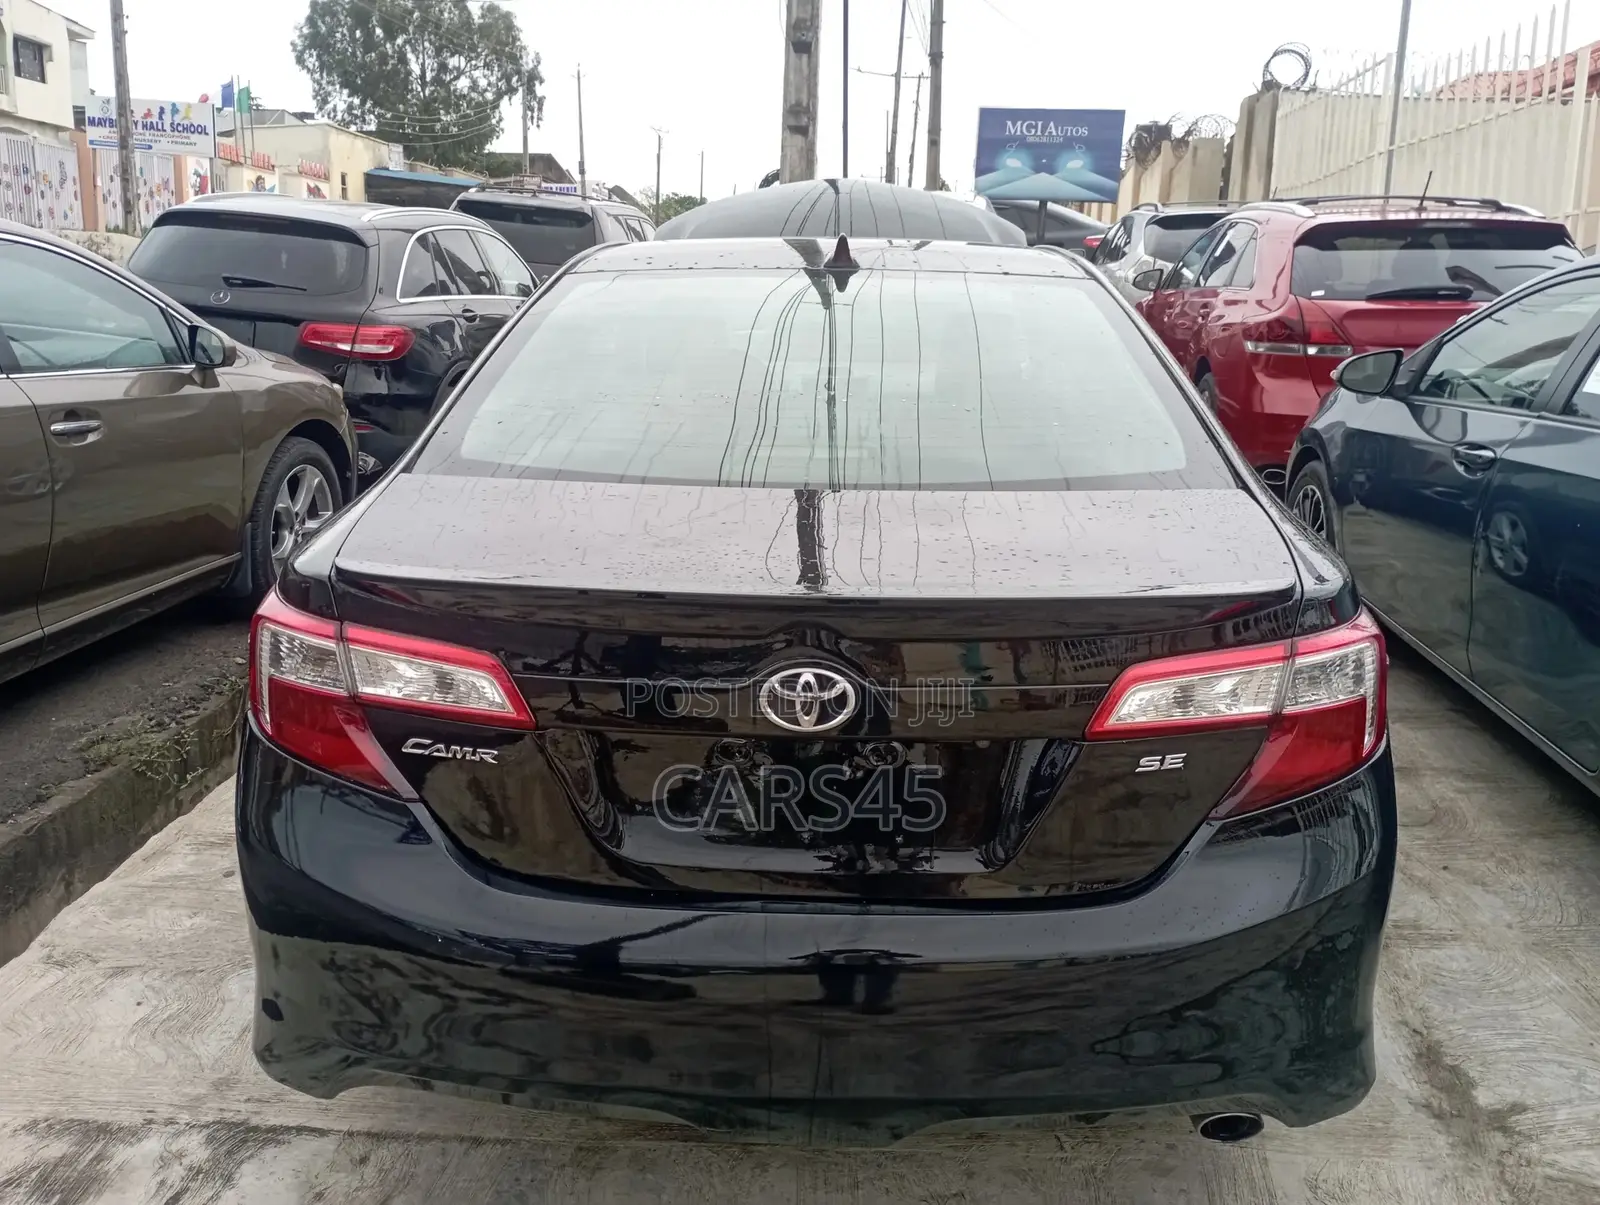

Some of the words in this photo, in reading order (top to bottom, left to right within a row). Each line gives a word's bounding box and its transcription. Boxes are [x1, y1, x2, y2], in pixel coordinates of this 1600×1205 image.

[87, 116, 140, 130] MAYBY
[141, 120, 167, 133] HALL
[170, 121, 210, 136] SCHOOL
[1005, 120, 1042, 136] MGI
[1135, 753, 1187, 772] SE
